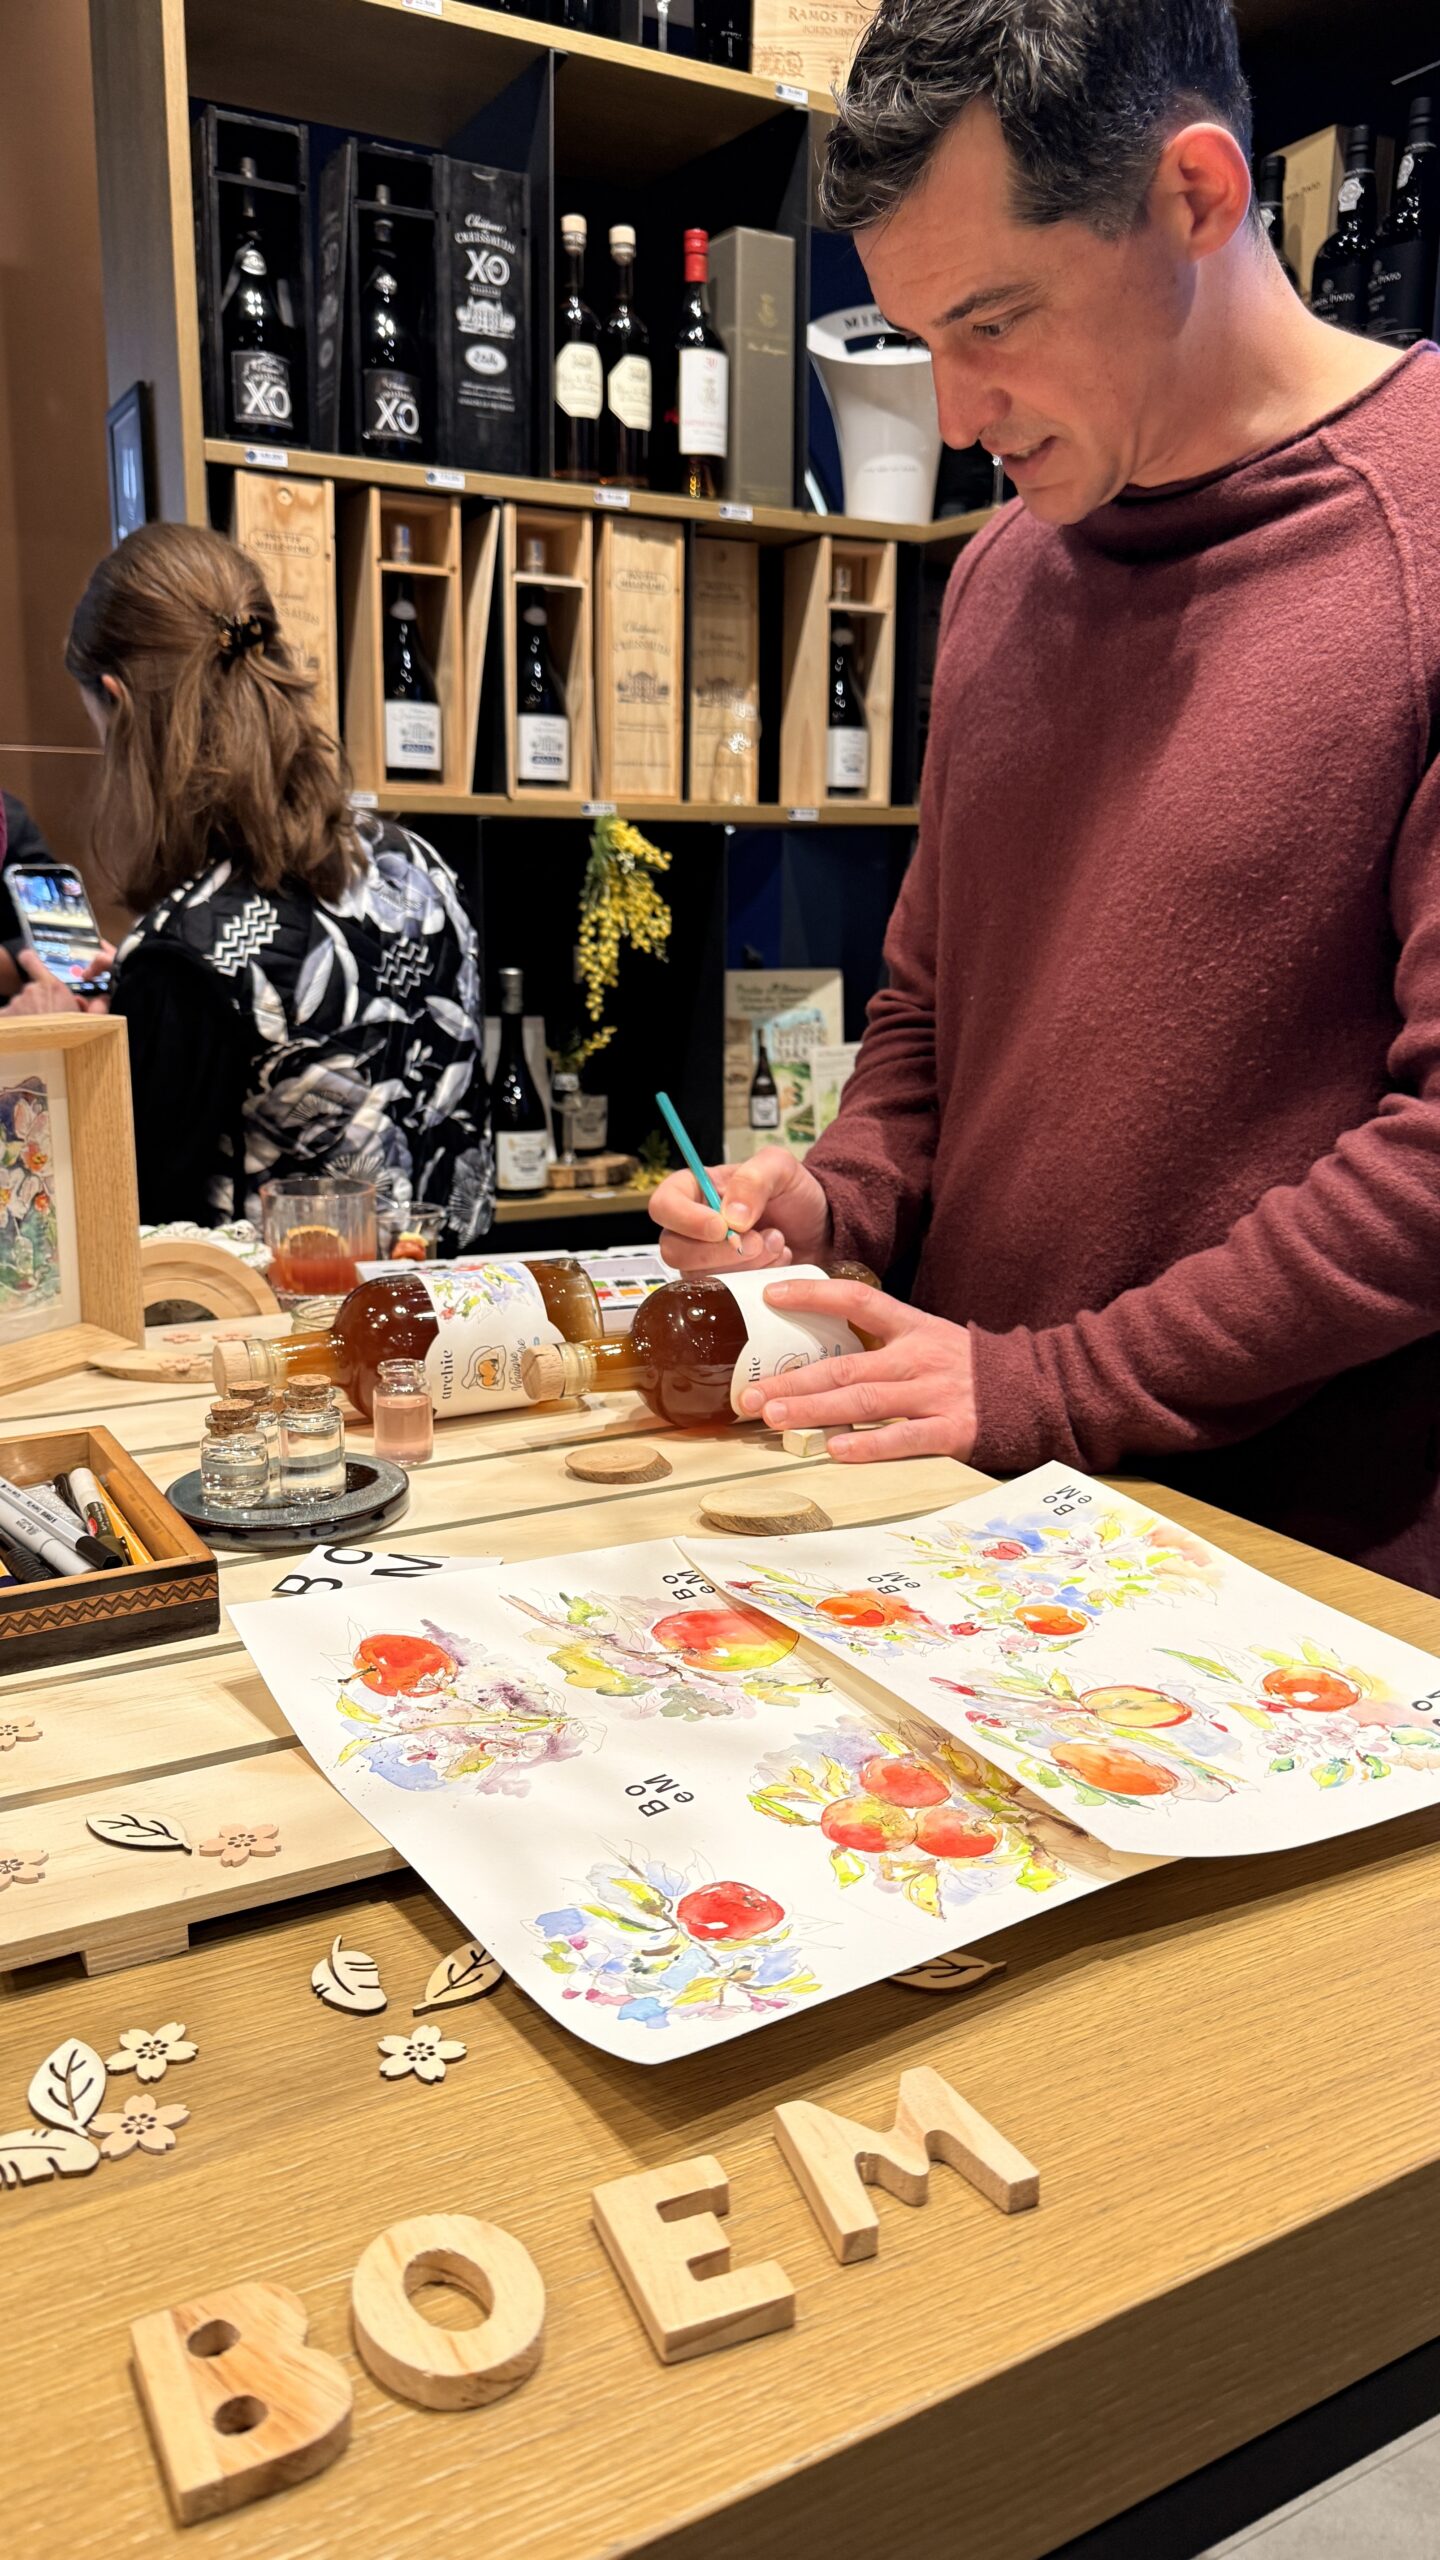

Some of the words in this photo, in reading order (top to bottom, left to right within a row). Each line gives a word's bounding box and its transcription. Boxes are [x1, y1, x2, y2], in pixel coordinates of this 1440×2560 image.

[788, 6, 838, 23] RAMOS
[844, 11, 873, 24] PIN
[465, 250, 510, 286] XO
[244, 379, 292, 419] XO
[375, 397, 420, 435] XO
[128, 2064, 1041, 2526] BOEM
